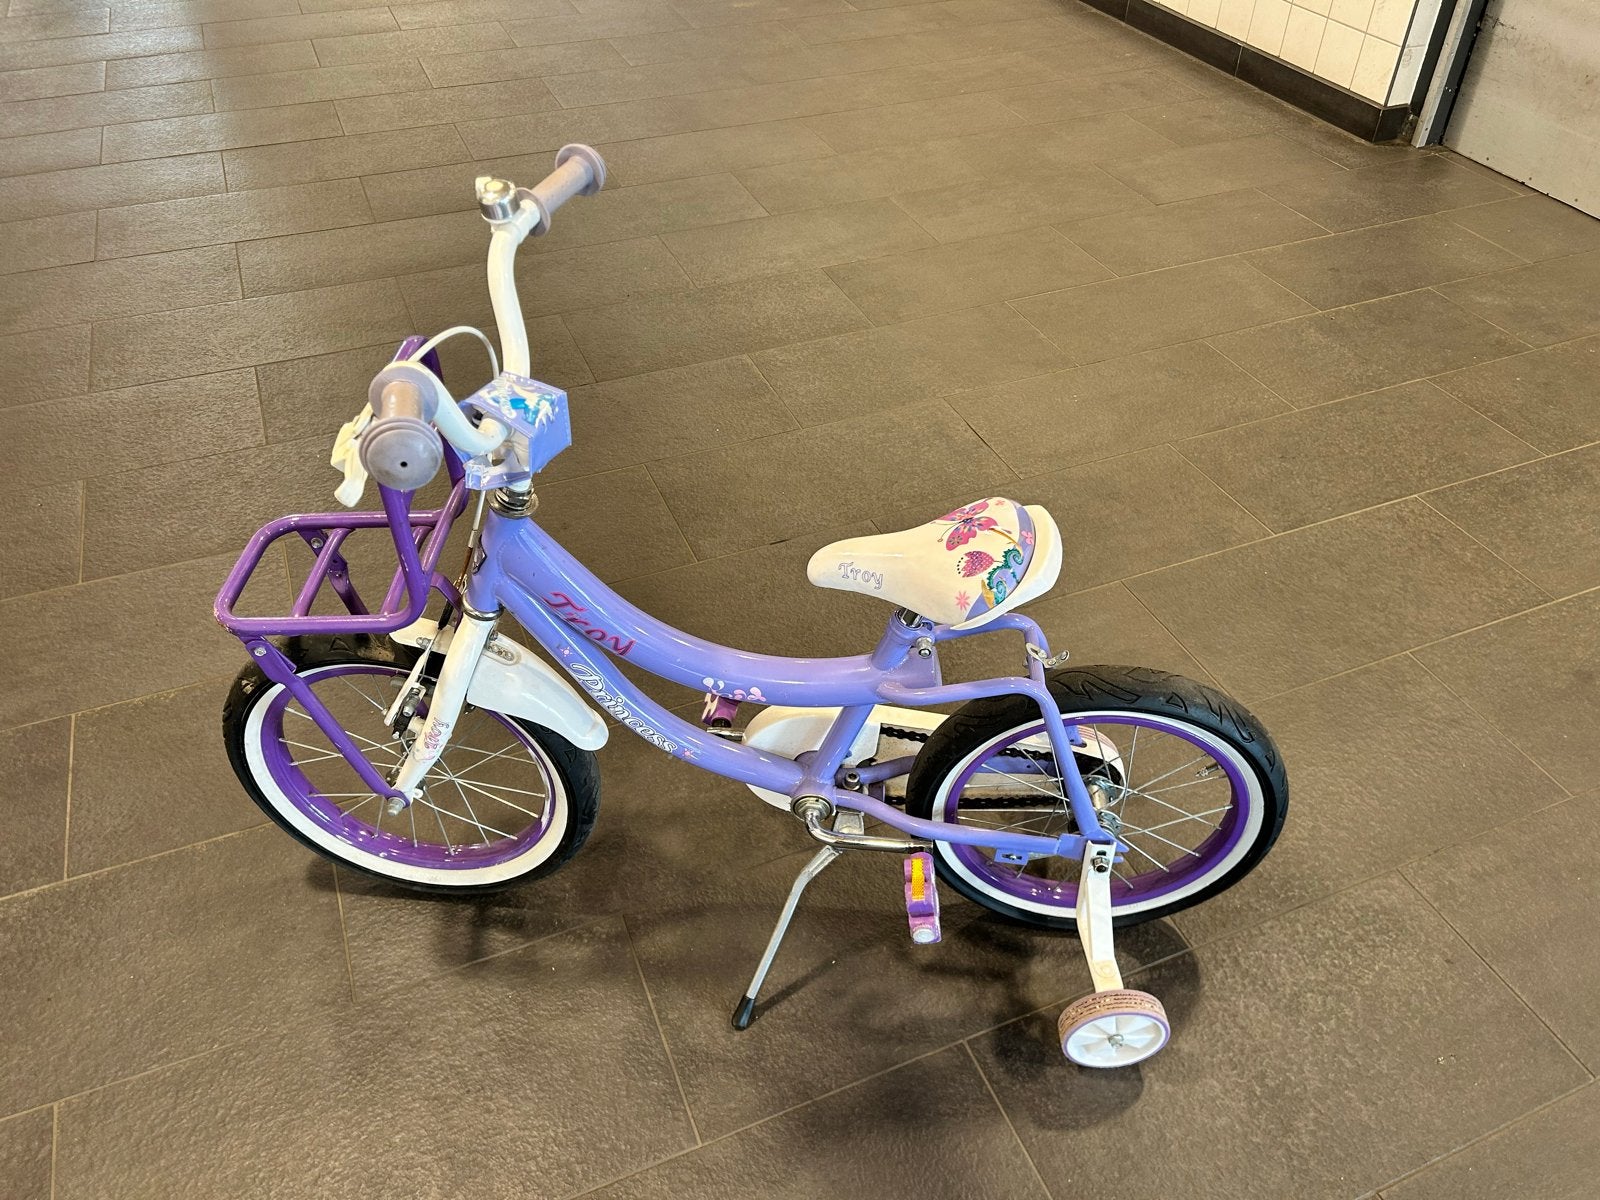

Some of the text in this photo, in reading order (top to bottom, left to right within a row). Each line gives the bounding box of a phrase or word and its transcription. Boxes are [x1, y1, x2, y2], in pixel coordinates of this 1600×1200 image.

[838, 561, 884, 590] Troy
[543, 592, 637, 656] Troy
[570, 662, 678, 754] Princess
